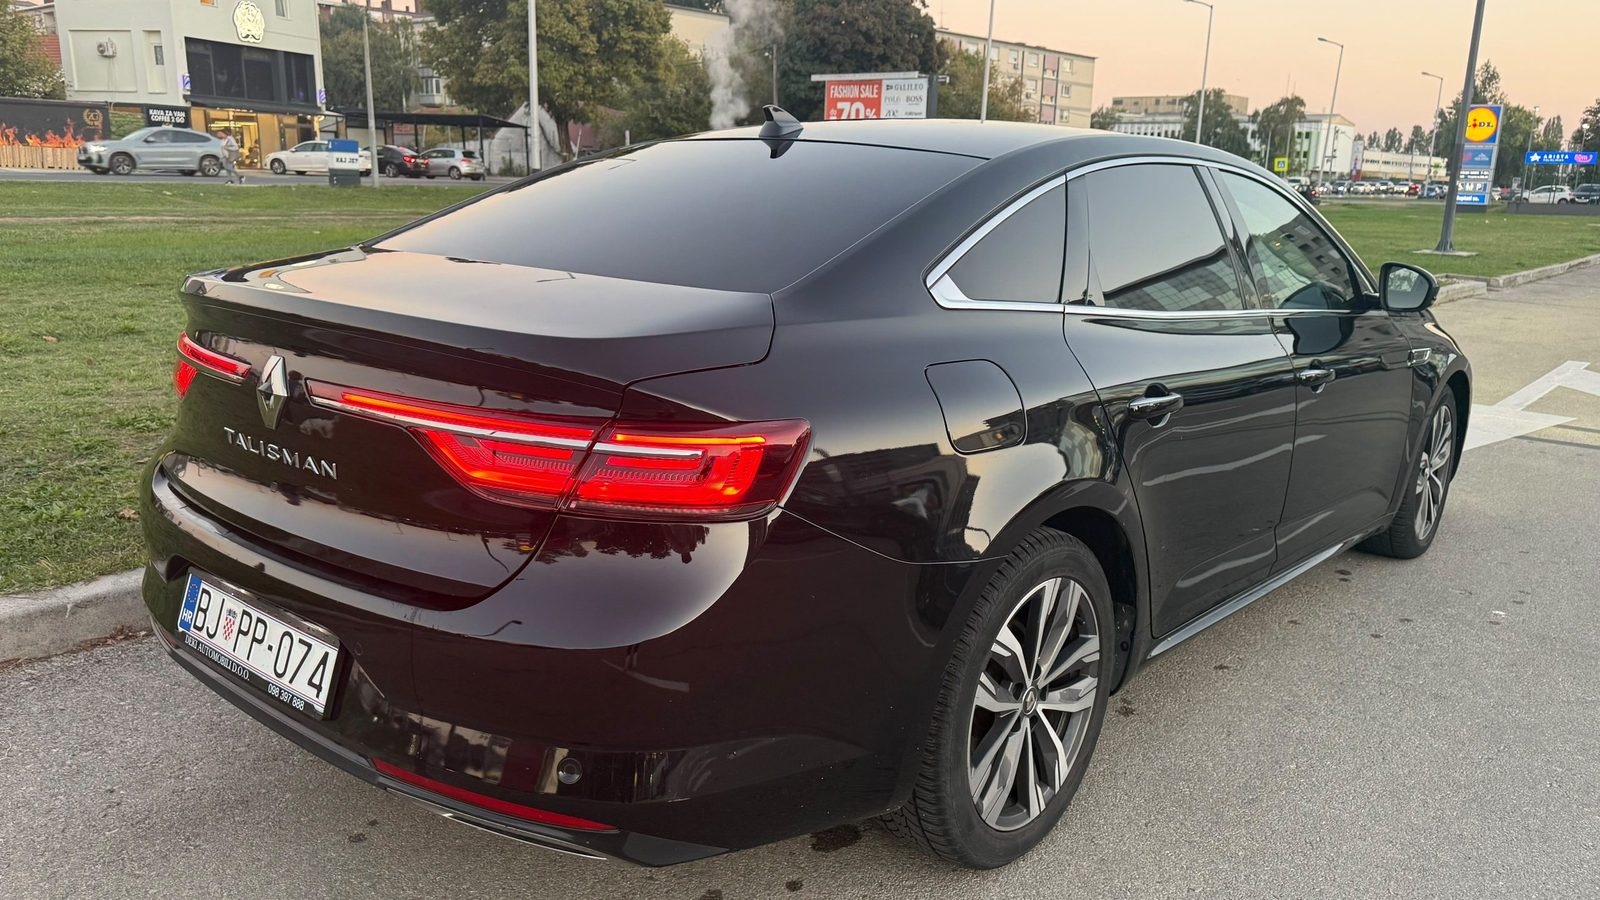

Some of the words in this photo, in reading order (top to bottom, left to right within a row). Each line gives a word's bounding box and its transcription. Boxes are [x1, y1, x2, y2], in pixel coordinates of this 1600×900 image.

[830, 85, 859, 98] FASHION
[860, 84, 879, 98] SALE
[906, 95, 922, 103] BOSS
[223, 426, 337, 480] TALISMAN
[181, 607, 193, 624] HR
[193, 587, 226, 640] BJ
[232, 608, 330, 699] PP-074
[184, 634, 198, 650] DEKI
[197, 640, 233, 671] AUTOMOBILI
[231, 665, 251, 681] D.O.O.
[267, 683, 280, 698] 098
[280, 689, 292, 704] 397
[291, 696, 305, 711] 888
